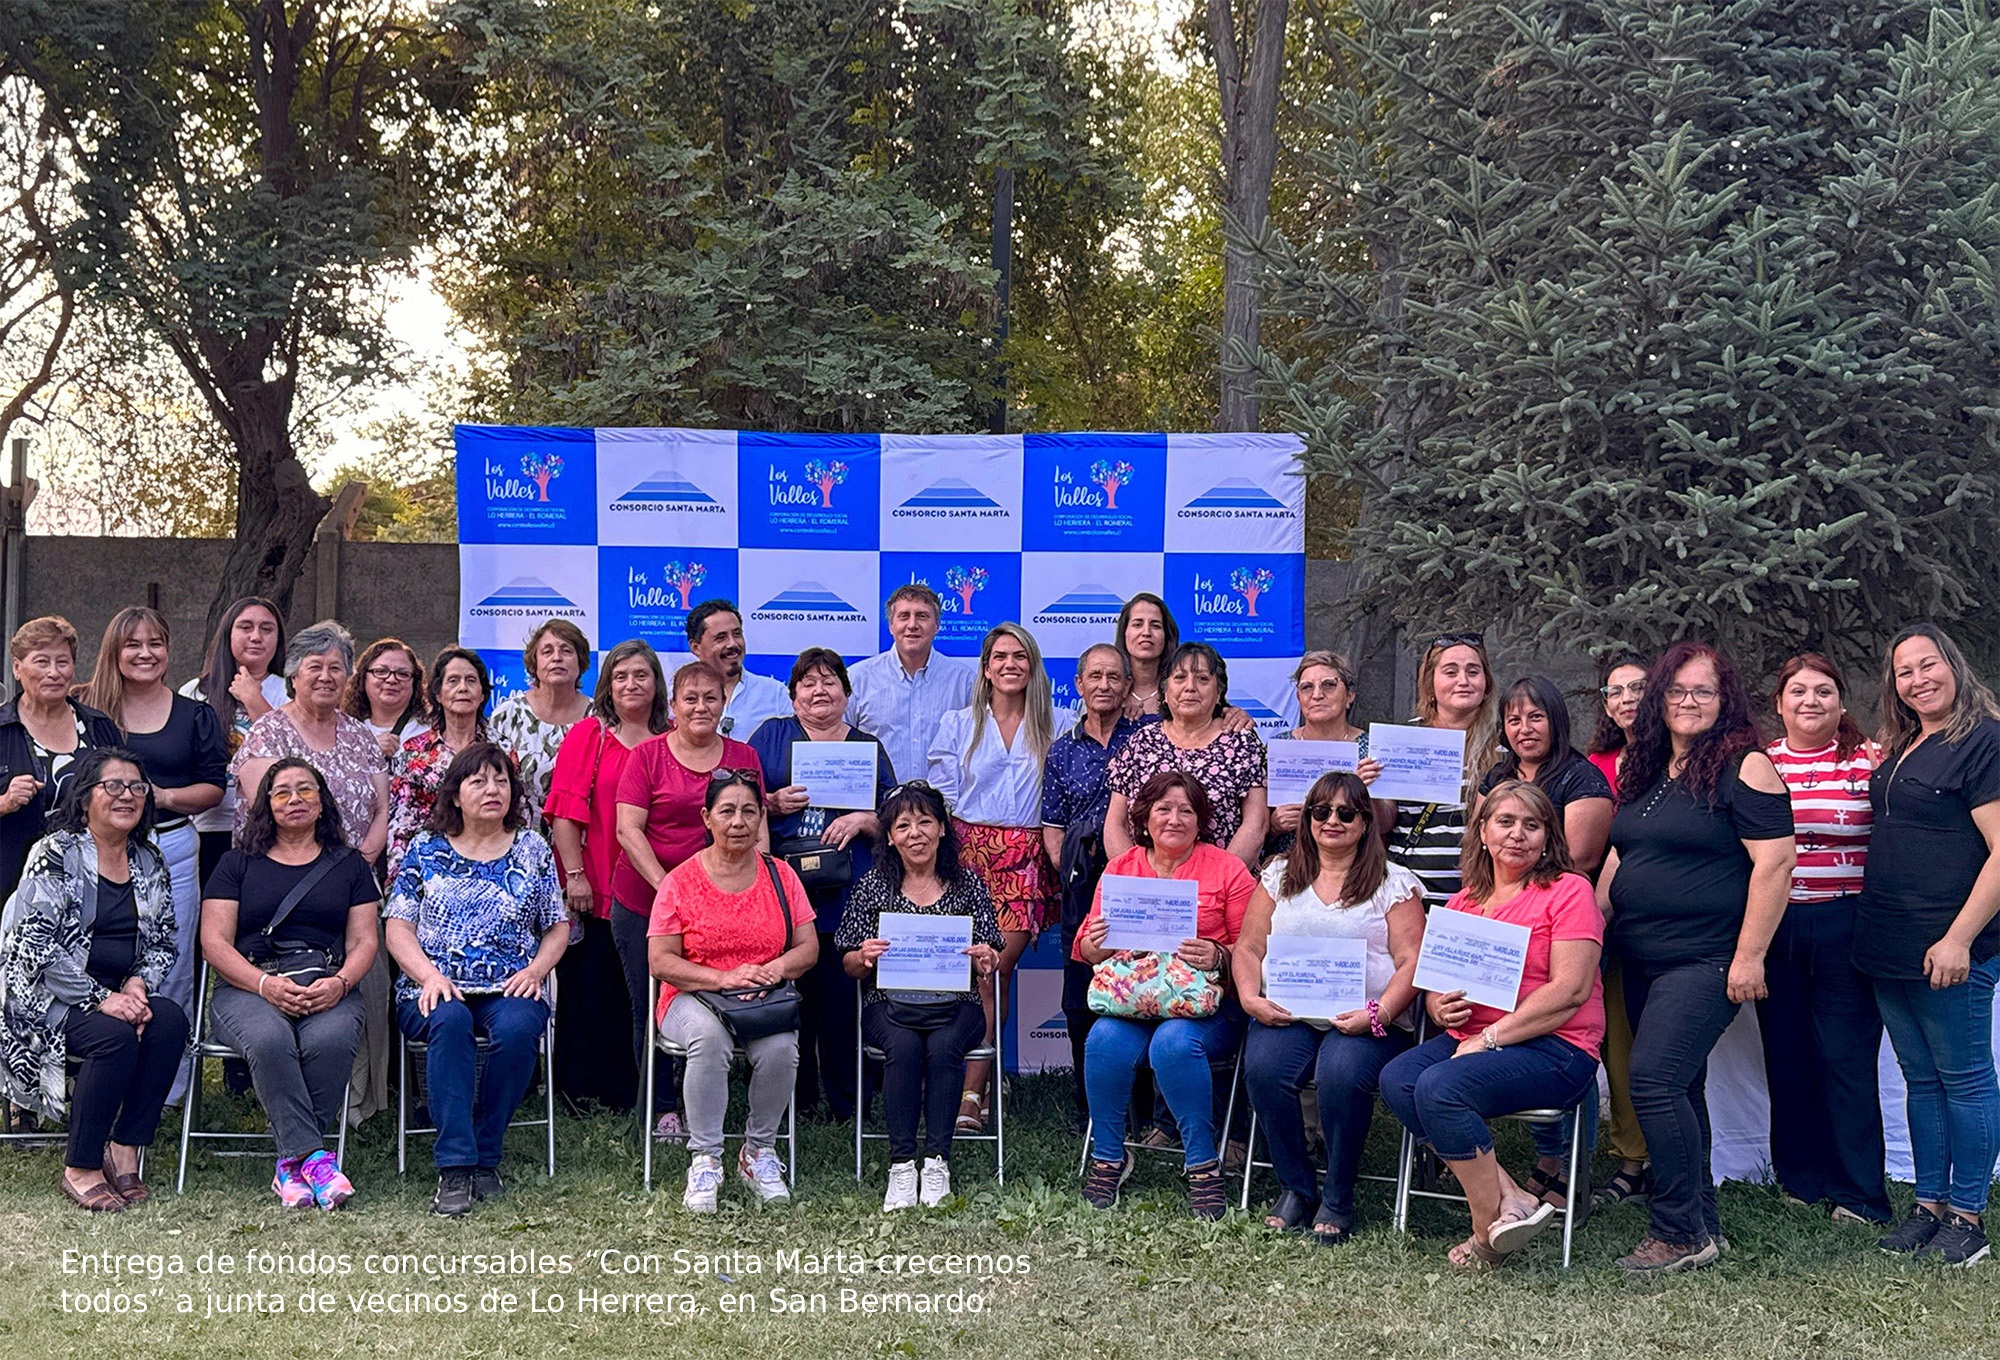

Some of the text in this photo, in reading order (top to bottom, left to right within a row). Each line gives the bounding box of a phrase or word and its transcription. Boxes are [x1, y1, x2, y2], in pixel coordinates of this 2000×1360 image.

[485, 457, 505, 477] Los
[769, 464, 789, 483] Los
[1054, 465, 1074, 484] Los
[485, 478, 536, 501] Valles
[769, 484, 819, 506] Valles
[1054, 486, 1104, 508] Valles
[609, 504, 726, 513] CONSORCIO SANTA MARTA
[892, 509, 1010, 517] CONSORCIO SANTA MARTA
[1177, 510, 1296, 519] CONSORCIO SANTA MARTA
[628, 566, 648, 585] Los
[1194, 573, 1214, 592] Los
[628, 586, 678, 608] Valles
[1194, 593, 1244, 616] Valles
[469, 608, 524, 616] CONSORCIO
[556, 609, 586, 617] MARTA
[751, 613, 867, 622] CONSORCIO SANTA MARTA
[1033, 616, 1087, 624] CONSORCIO
[489, 668, 509, 687] Los
[1260, 720, 1290, 728] MARTA
[1029, 1031, 1068, 1039] CONSOR
